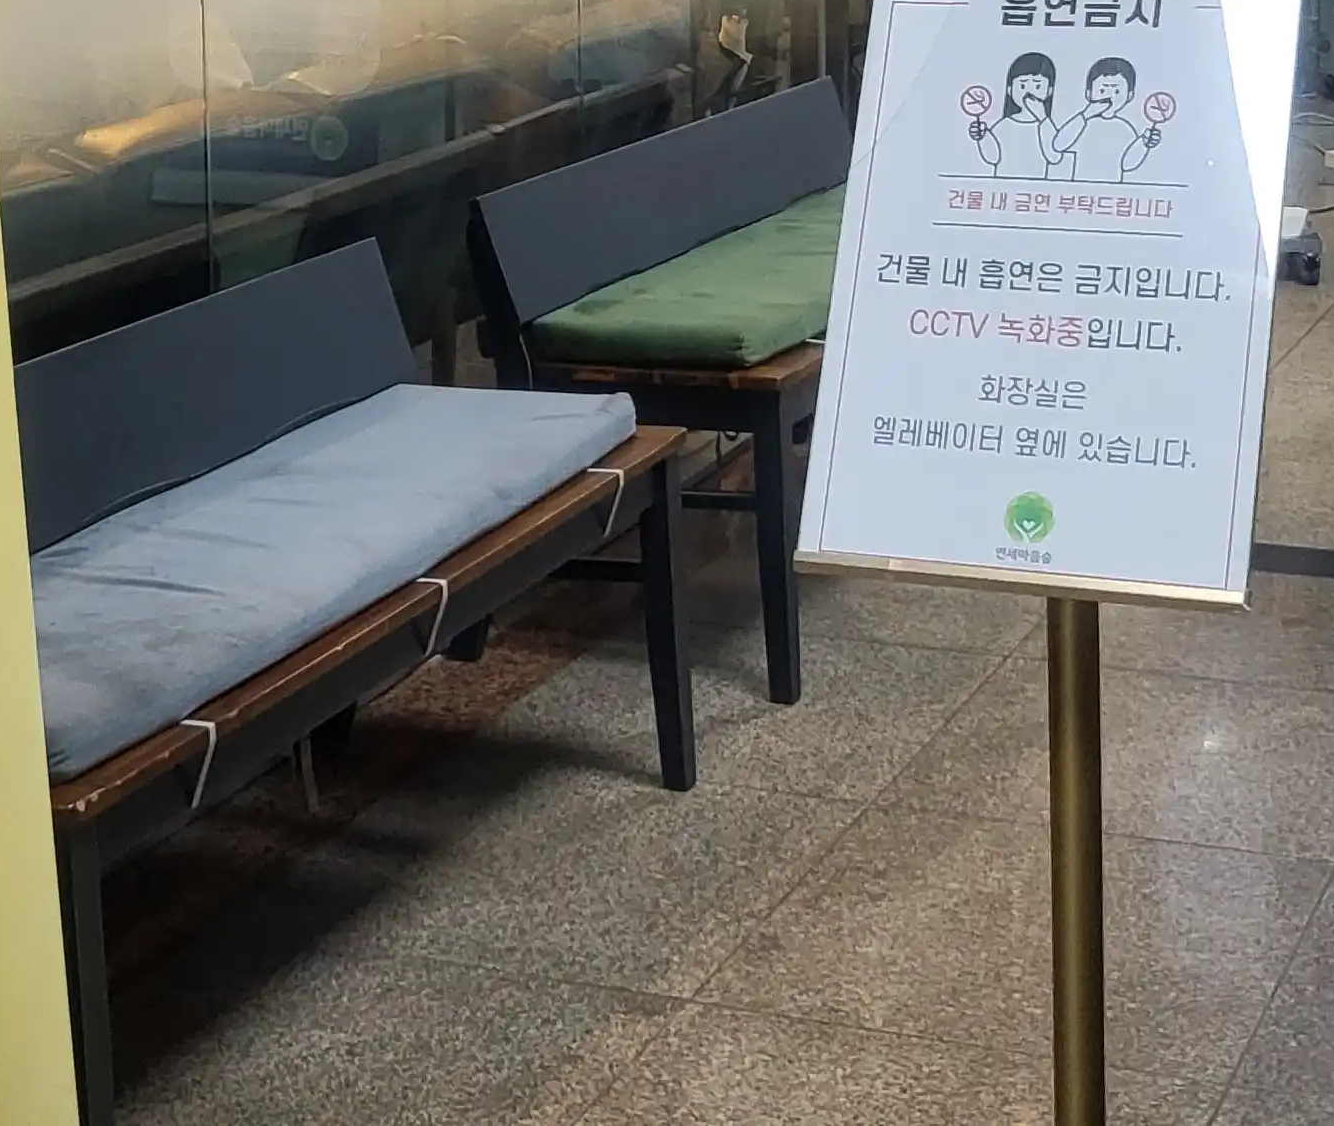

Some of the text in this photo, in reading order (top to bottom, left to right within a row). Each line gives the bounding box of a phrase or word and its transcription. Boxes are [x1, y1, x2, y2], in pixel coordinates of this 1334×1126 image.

[949, 189, 1171, 218] 건물 내 금연 부탁드립니다
[878, 254, 1229, 301] 건물 내 흡연은 금지입니다.
[910, 310, 1181, 352] CCTV 녹화중입니다.
[980, 375, 1085, 409] 화장실은
[874, 417, 1195, 468] 엘레베이터 옆에 있습니다.
